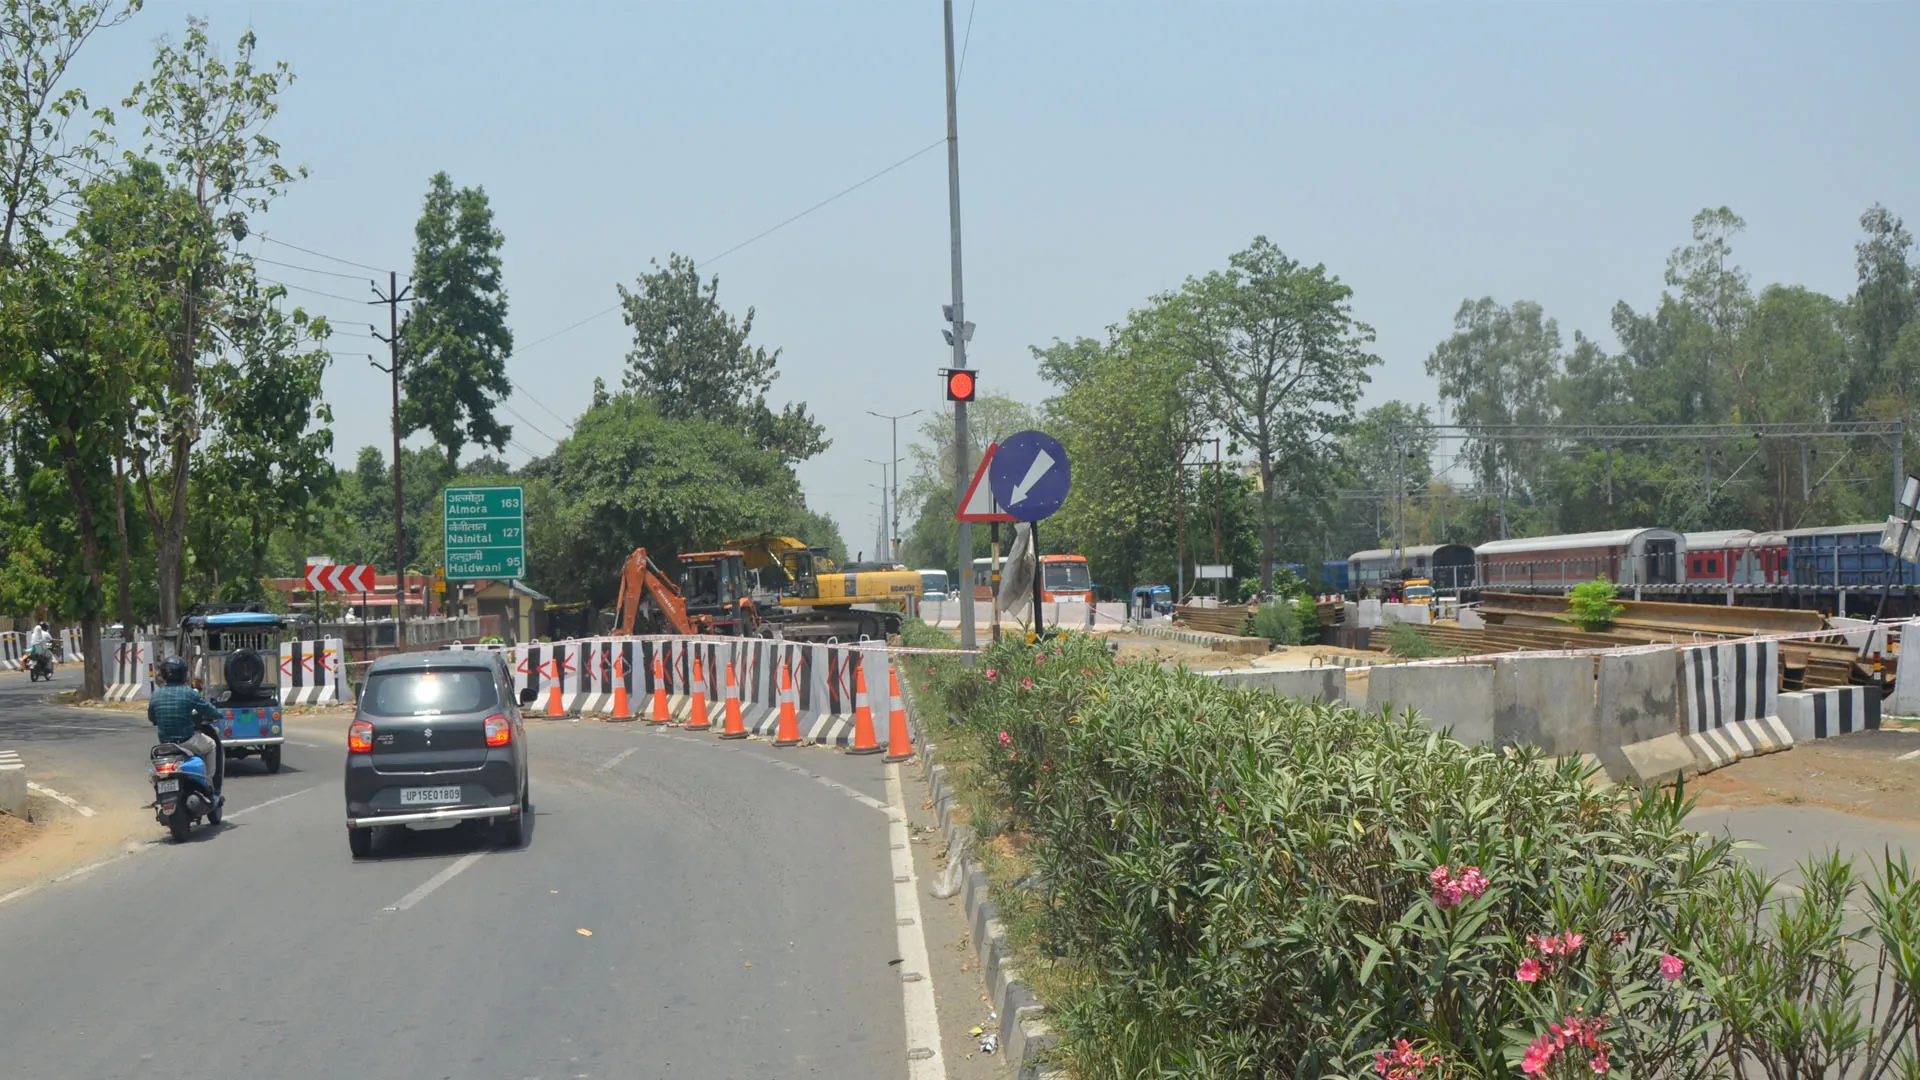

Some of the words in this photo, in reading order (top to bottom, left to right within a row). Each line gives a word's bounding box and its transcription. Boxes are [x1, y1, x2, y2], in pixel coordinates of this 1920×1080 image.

[501, 499, 519, 508] 163
[448, 506, 488, 514] Almora
[503, 528, 520, 537] 127
[448, 534, 492, 544] Nainital
[506, 557, 521, 567] 95
[448, 562, 502, 573] Haldwani
